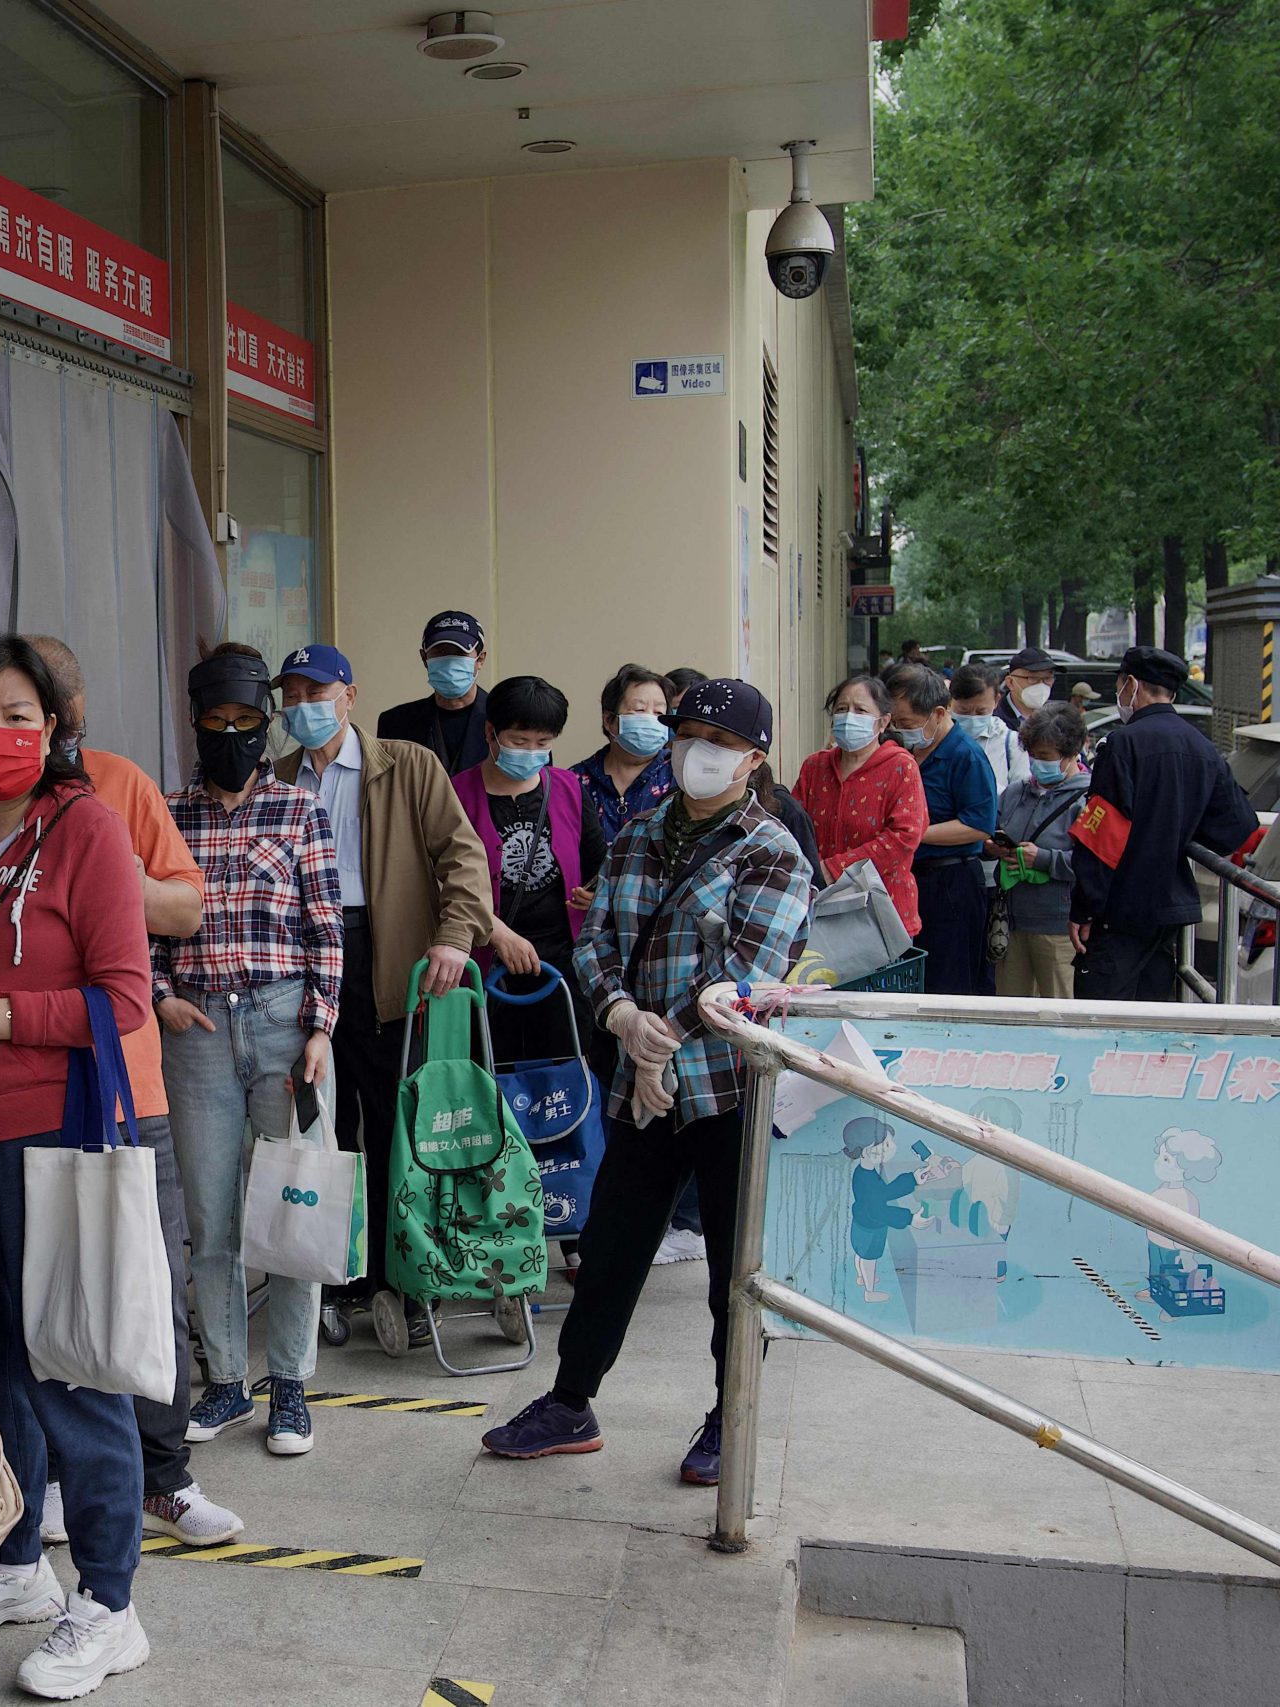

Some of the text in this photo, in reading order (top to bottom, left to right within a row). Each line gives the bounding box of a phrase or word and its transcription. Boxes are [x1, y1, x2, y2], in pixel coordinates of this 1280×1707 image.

[86, 246, 153, 318] 服务无限
[681, 379, 711, 389] Video
[293, 647, 310, 665] LA
[431, 1106, 473, 1134] 超能
[545, 1103, 573, 1121] 男士
